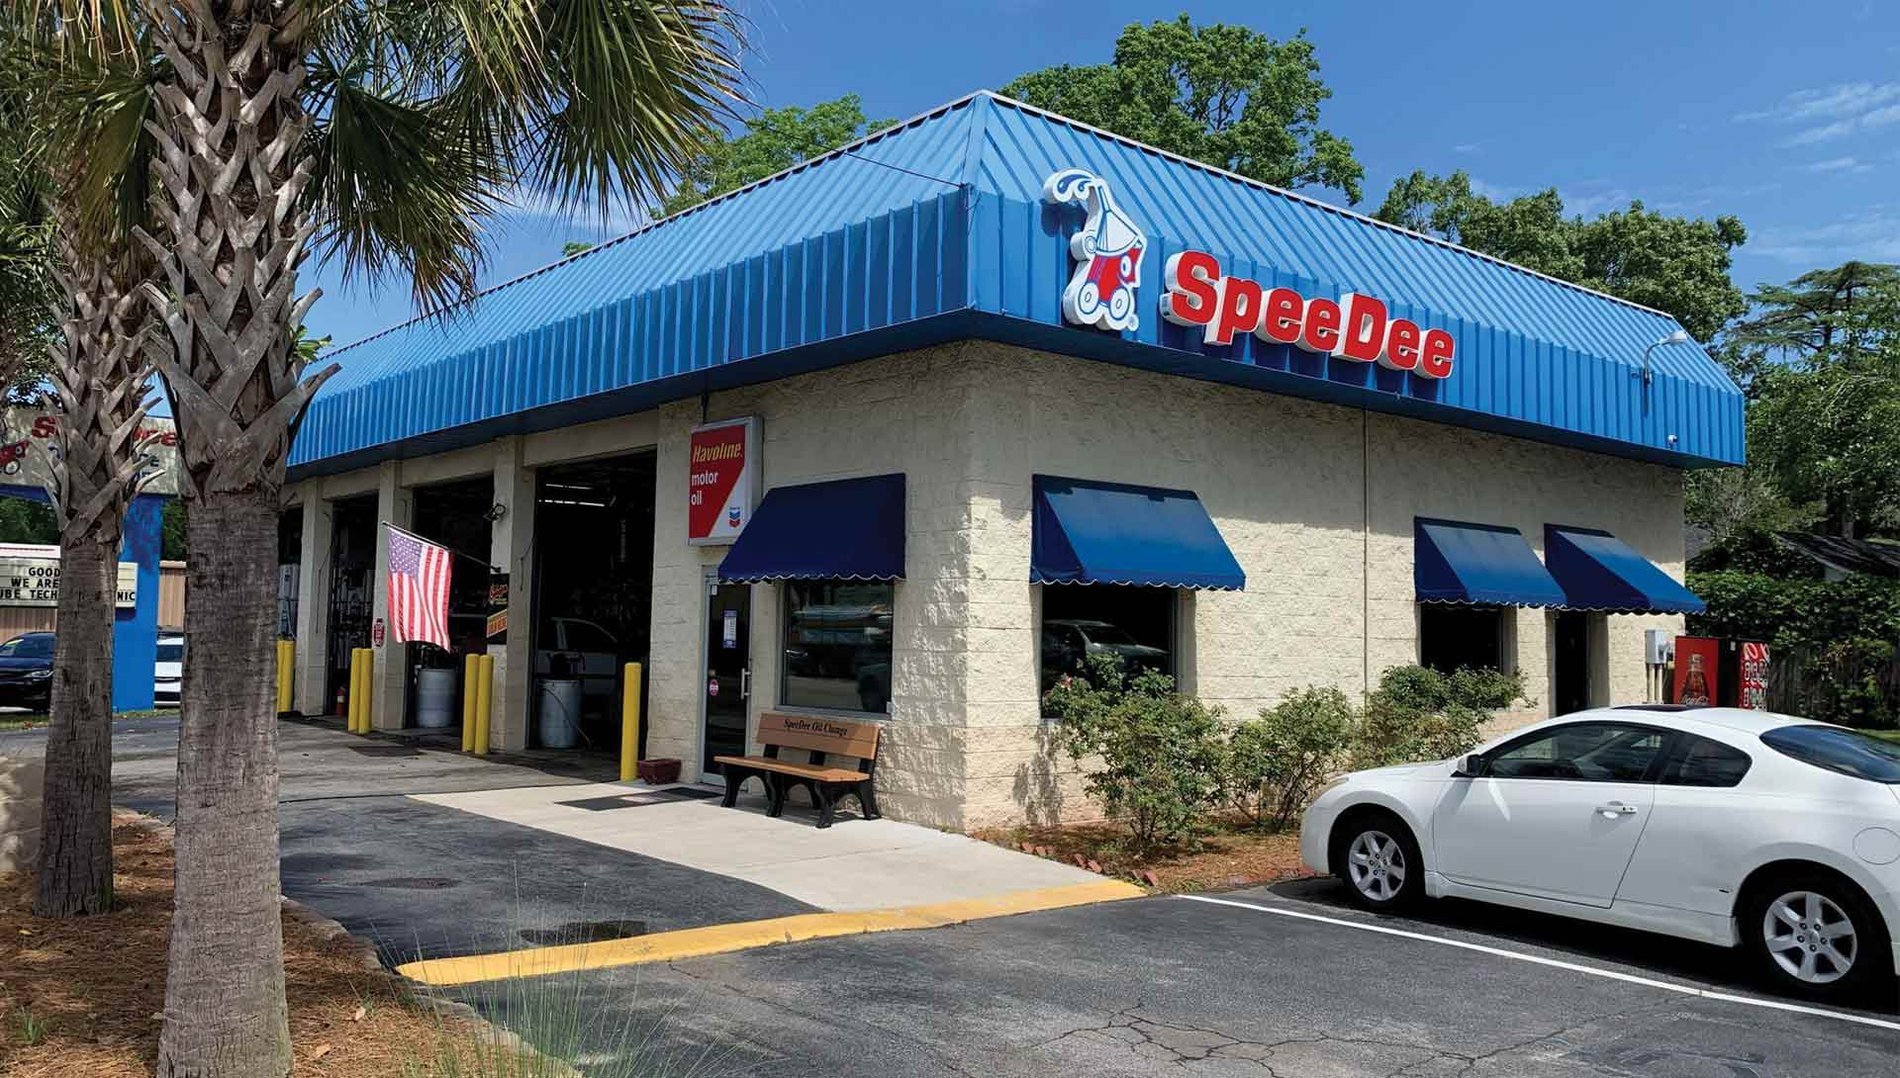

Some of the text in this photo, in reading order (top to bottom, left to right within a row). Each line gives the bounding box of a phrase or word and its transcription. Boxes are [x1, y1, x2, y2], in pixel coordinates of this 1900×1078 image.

[1161, 250, 1455, 379] SpeeDee
[692, 442, 741, 463] Havoline
[691, 470, 719, 486] motor
[690, 490, 703, 506] oil
[28, 567, 61, 577] GOOD
[11, 577, 59, 589] WE ARE
